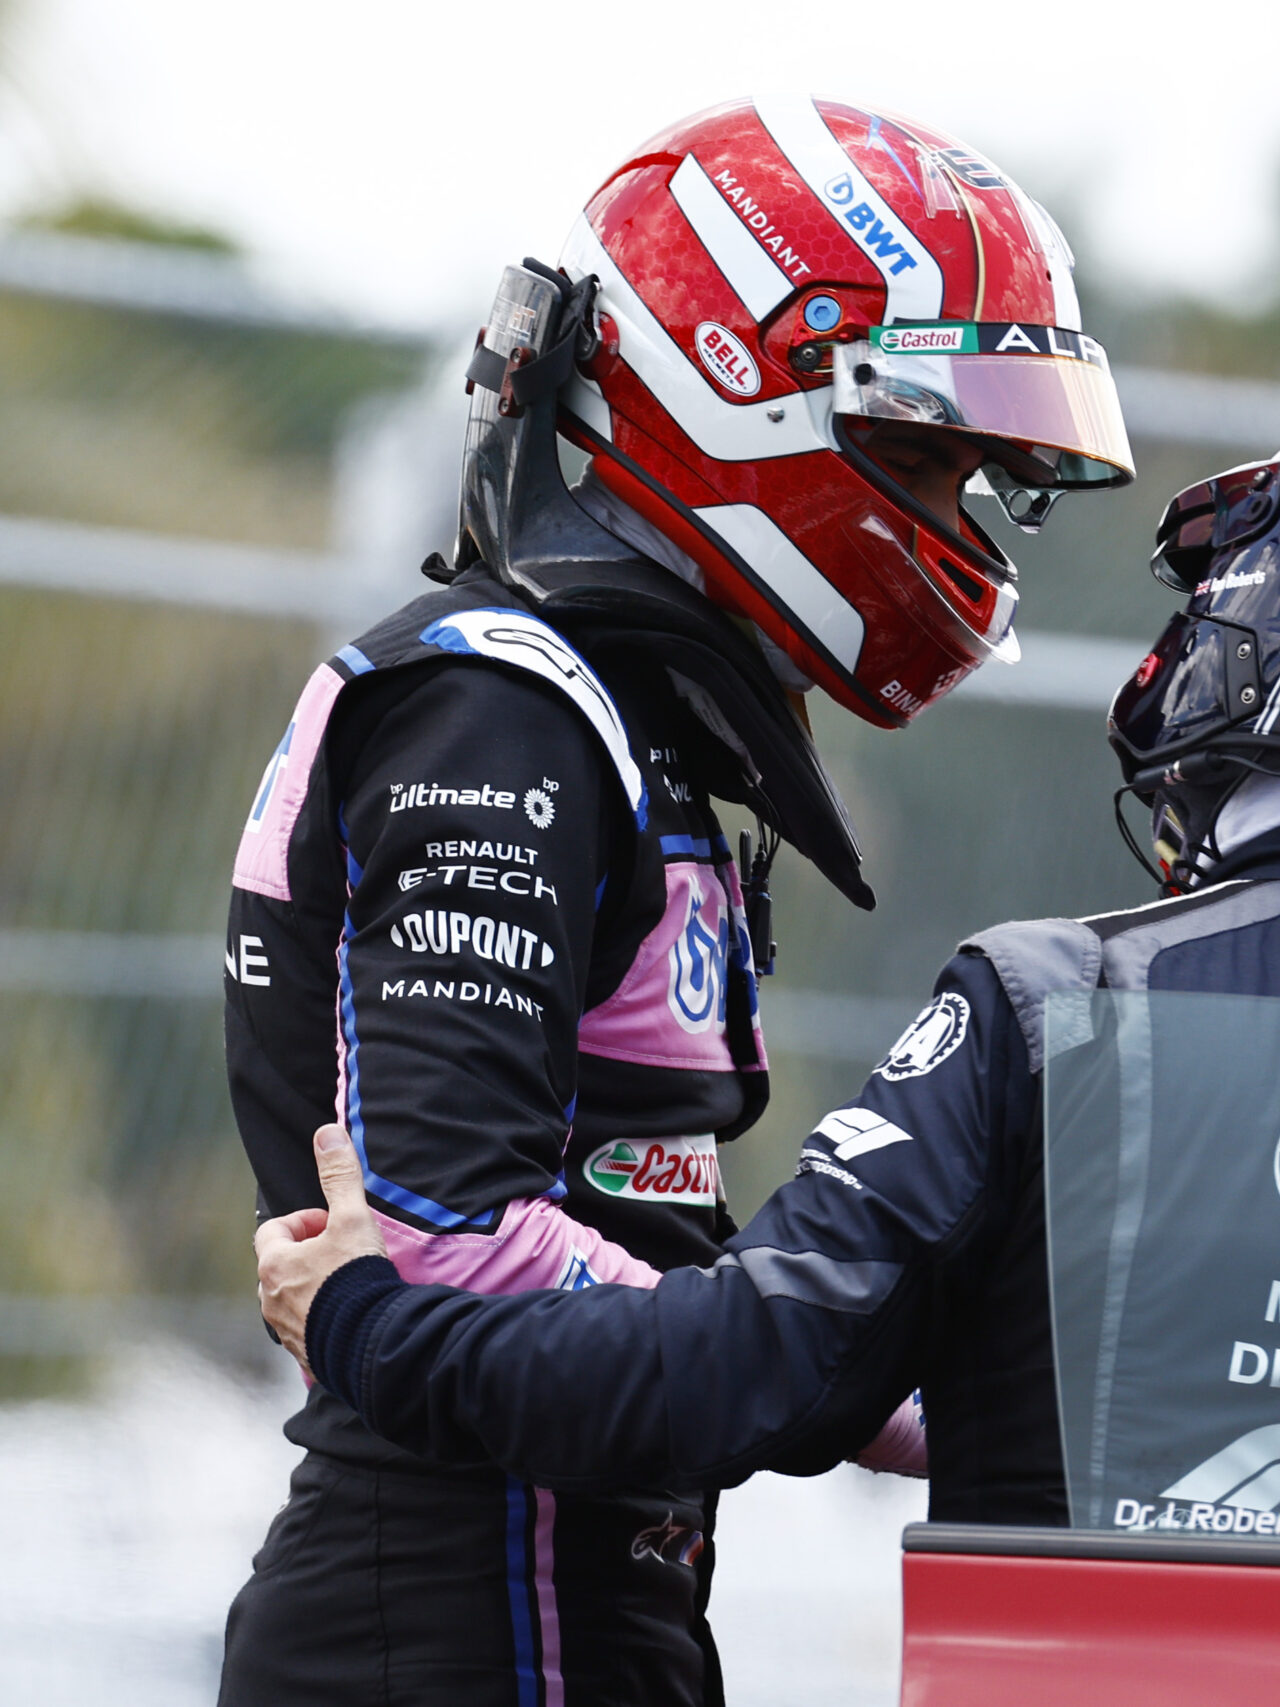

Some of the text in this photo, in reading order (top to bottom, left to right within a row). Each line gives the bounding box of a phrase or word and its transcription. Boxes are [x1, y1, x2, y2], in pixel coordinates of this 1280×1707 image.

[714, 168, 812, 277] MANDIANT
[844, 201, 918, 276] BWT
[703, 329, 749, 386] BELL
[900, 331, 957, 349] Castrol
[389, 783, 516, 813] ultimate
[543, 776, 560, 793] bp
[425, 840, 538, 865] RENAULT
[397, 865, 558, 906] E-TECH
[402, 909, 538, 970] DUPONT
[381, 979, 544, 1022] MANDIANT
[1113, 1498, 1156, 1528] Dr.
